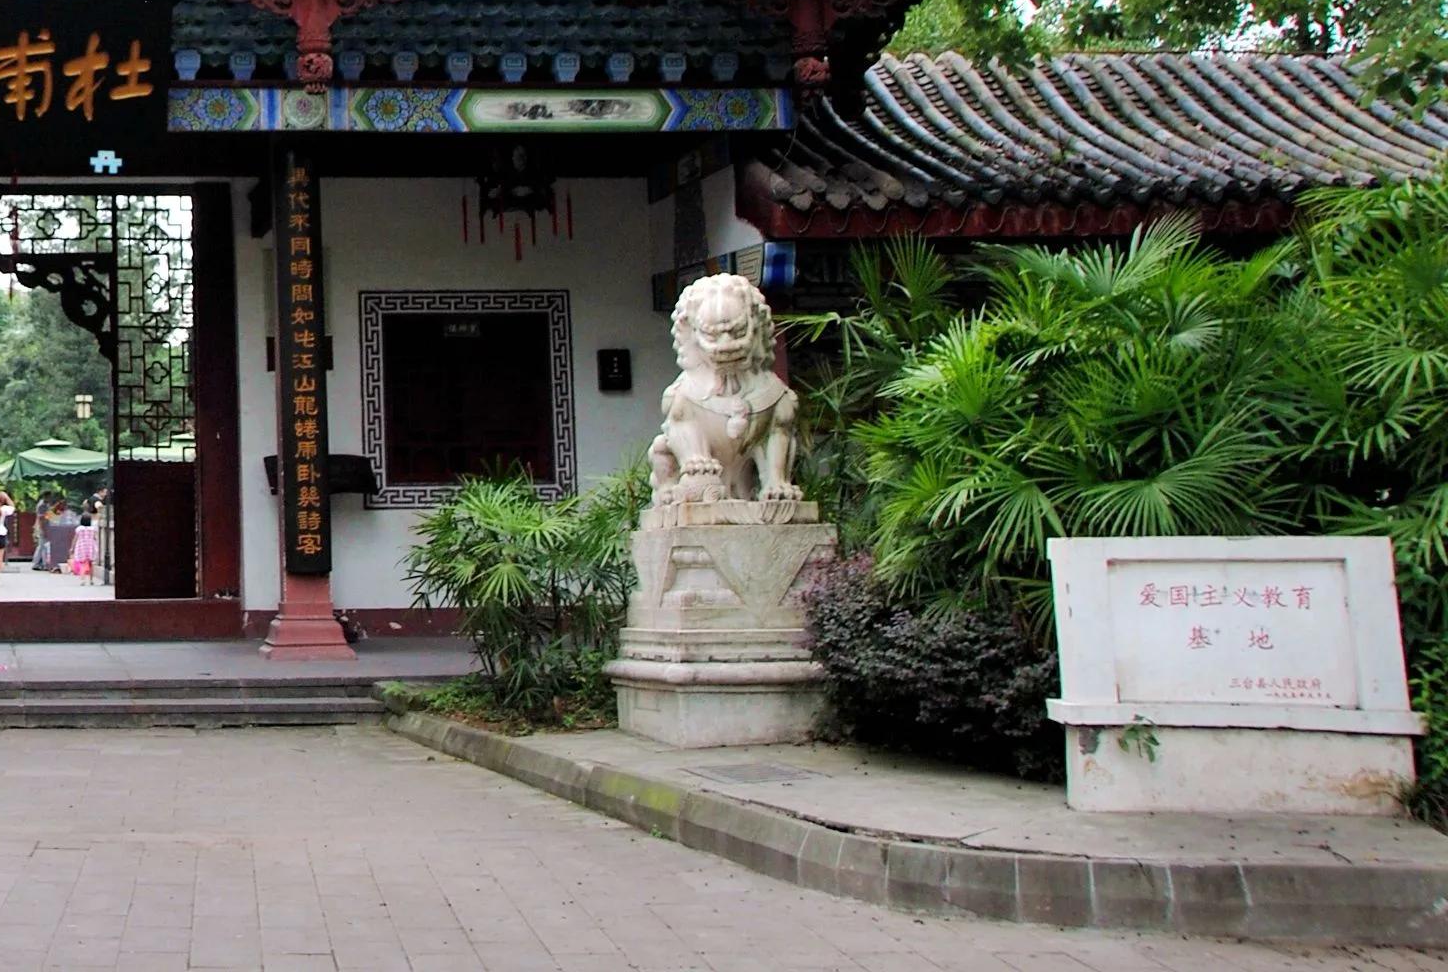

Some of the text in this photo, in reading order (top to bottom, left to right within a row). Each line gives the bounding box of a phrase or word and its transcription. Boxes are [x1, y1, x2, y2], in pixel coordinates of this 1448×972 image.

[1139, 583, 1314, 610] 爱国主义教育
[1187, 625, 1275, 650] 基地
